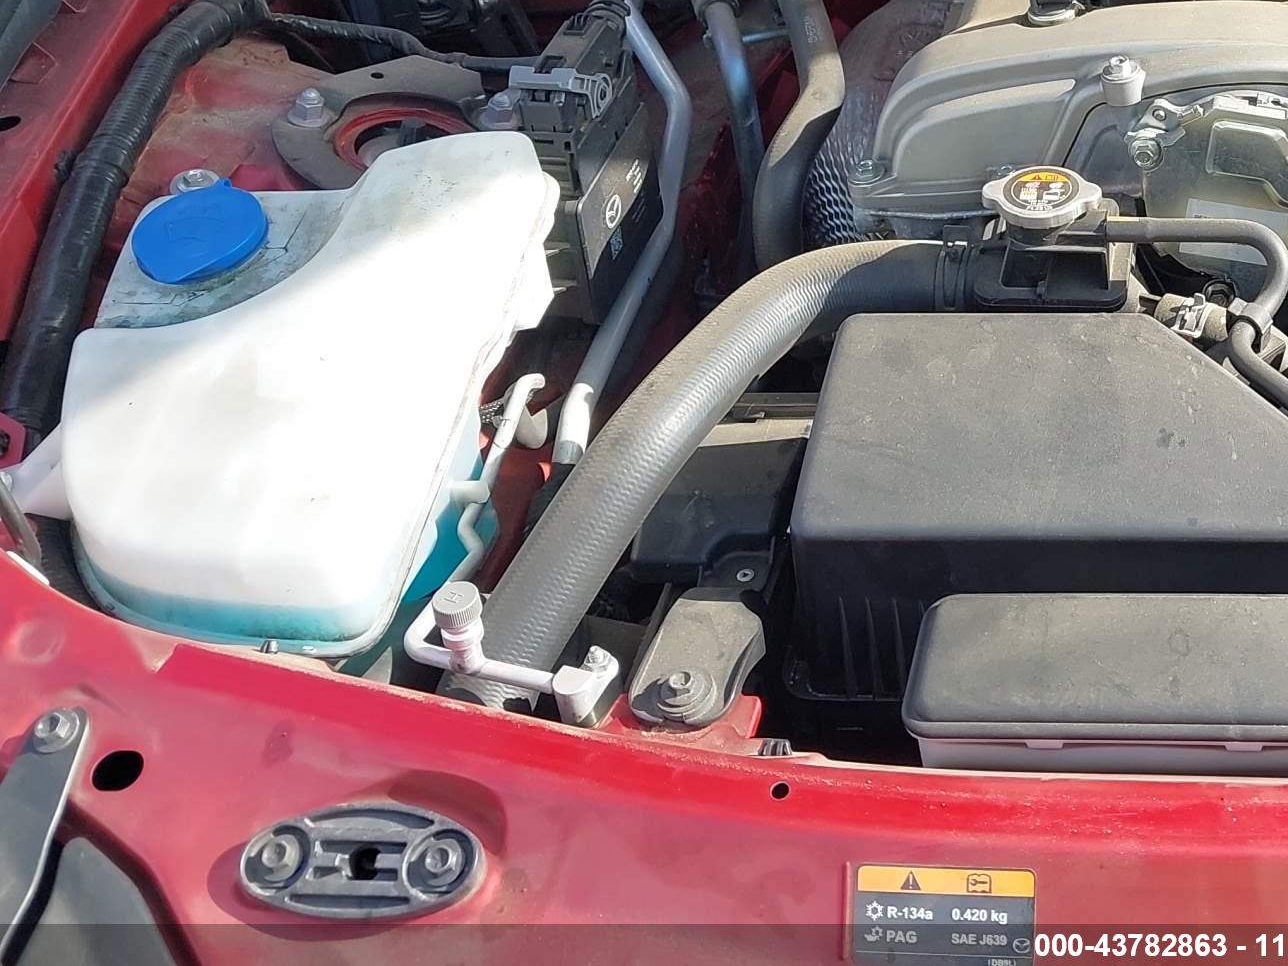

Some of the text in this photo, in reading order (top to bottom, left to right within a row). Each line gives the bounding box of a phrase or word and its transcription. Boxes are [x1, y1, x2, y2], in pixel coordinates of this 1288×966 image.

[886, 906, 1008, 925] R-134a 0.420 kg
[886, 930, 1008, 946] PAG SAE J639
